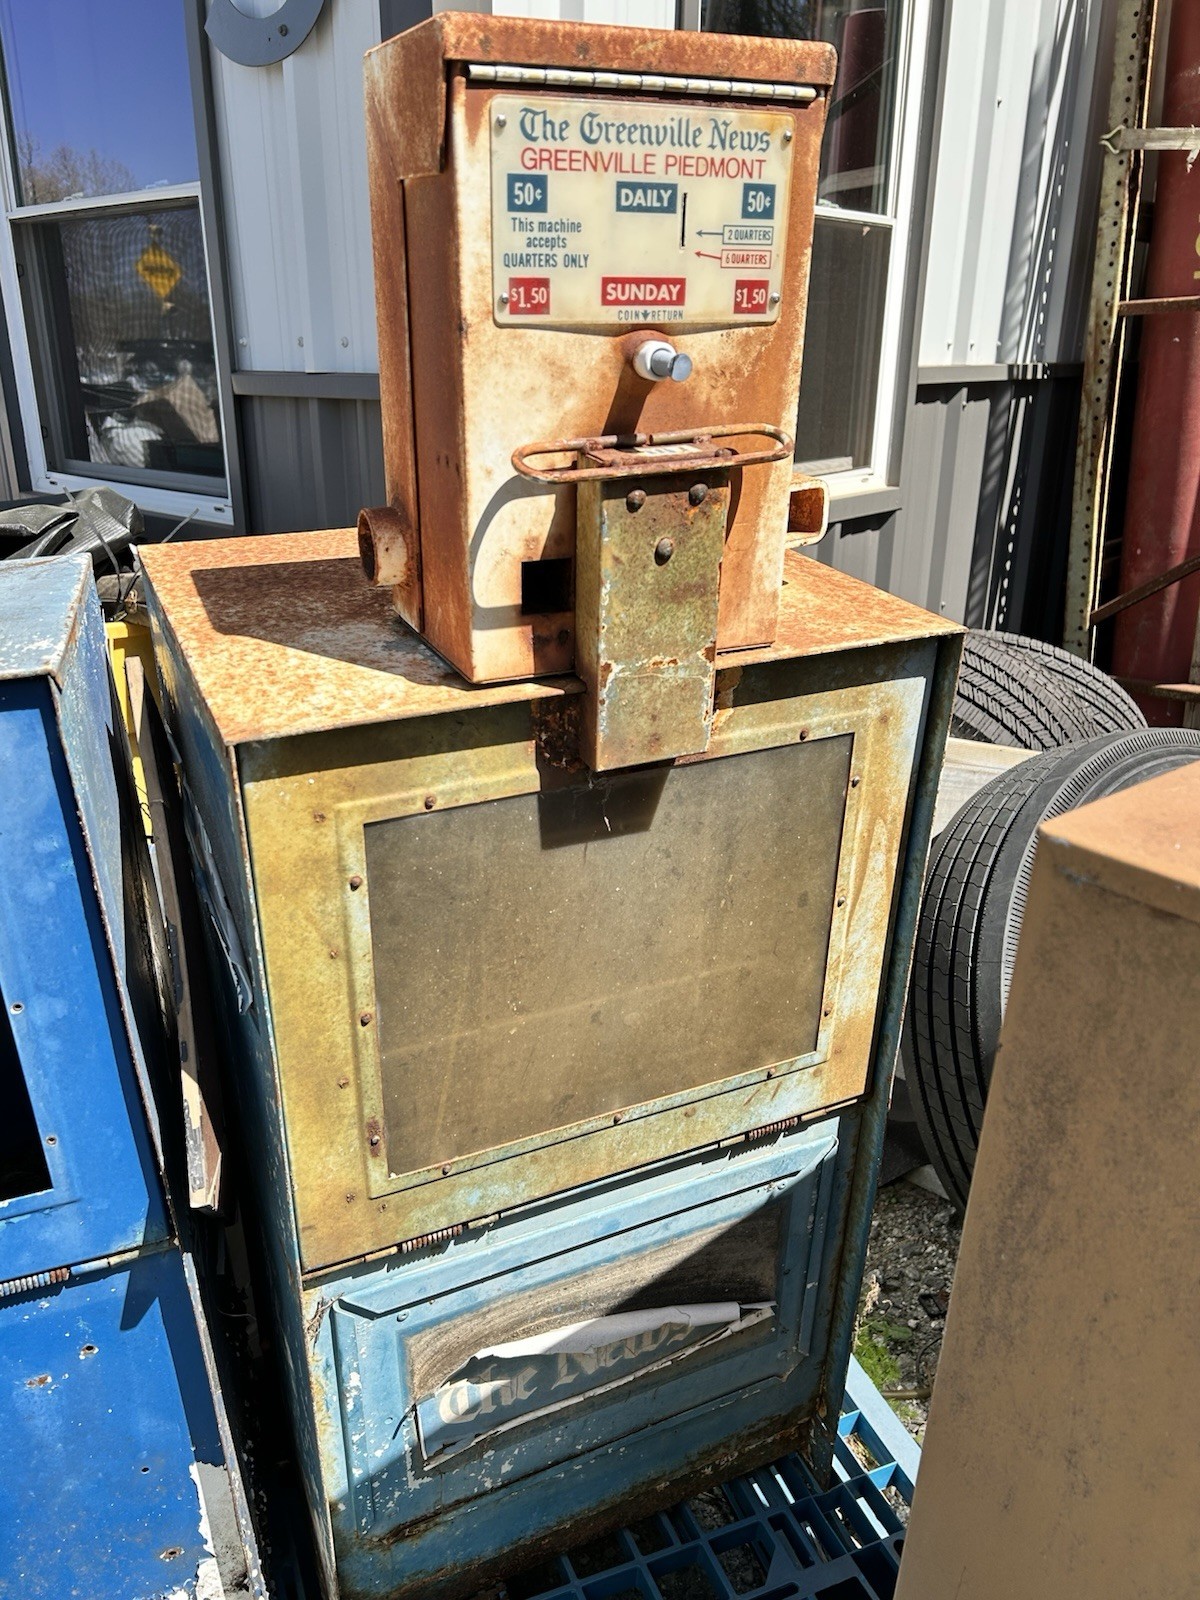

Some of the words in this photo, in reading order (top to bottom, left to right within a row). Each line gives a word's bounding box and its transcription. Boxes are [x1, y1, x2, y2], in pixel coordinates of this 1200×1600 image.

[520, 107, 570, 143] The
[580, 112, 703, 148] Greenville
[708, 118, 770, 152] News
[520, 147, 656, 175] GREENVILLE
[665, 155, 766, 179] PIEDMONT
[513, 182, 542, 206] 50¢
[620, 188, 672, 207] DAILY
[747, 191, 772, 212] 50¢
[511, 218, 534, 232] This
[538, 219, 582, 233] machine
[526, 235, 567, 251] accepts
[728, 230, 733, 240] 2
[734, 230, 772, 241] QUARTERS
[503, 253, 557, 268] QUARTERS
[563, 254, 590, 268] ONLY
[725, 253, 731, 263] 6
[731, 253, 767, 265] QUARTERS
[511, 287, 547, 308] $1.50
[606, 284, 681, 301] SUNDAY
[736, 288, 766, 308] $1.50
[618, 310, 640, 320] COIN
[651, 310, 684, 320] RETURN
[439, 1363, 537, 1424] The
